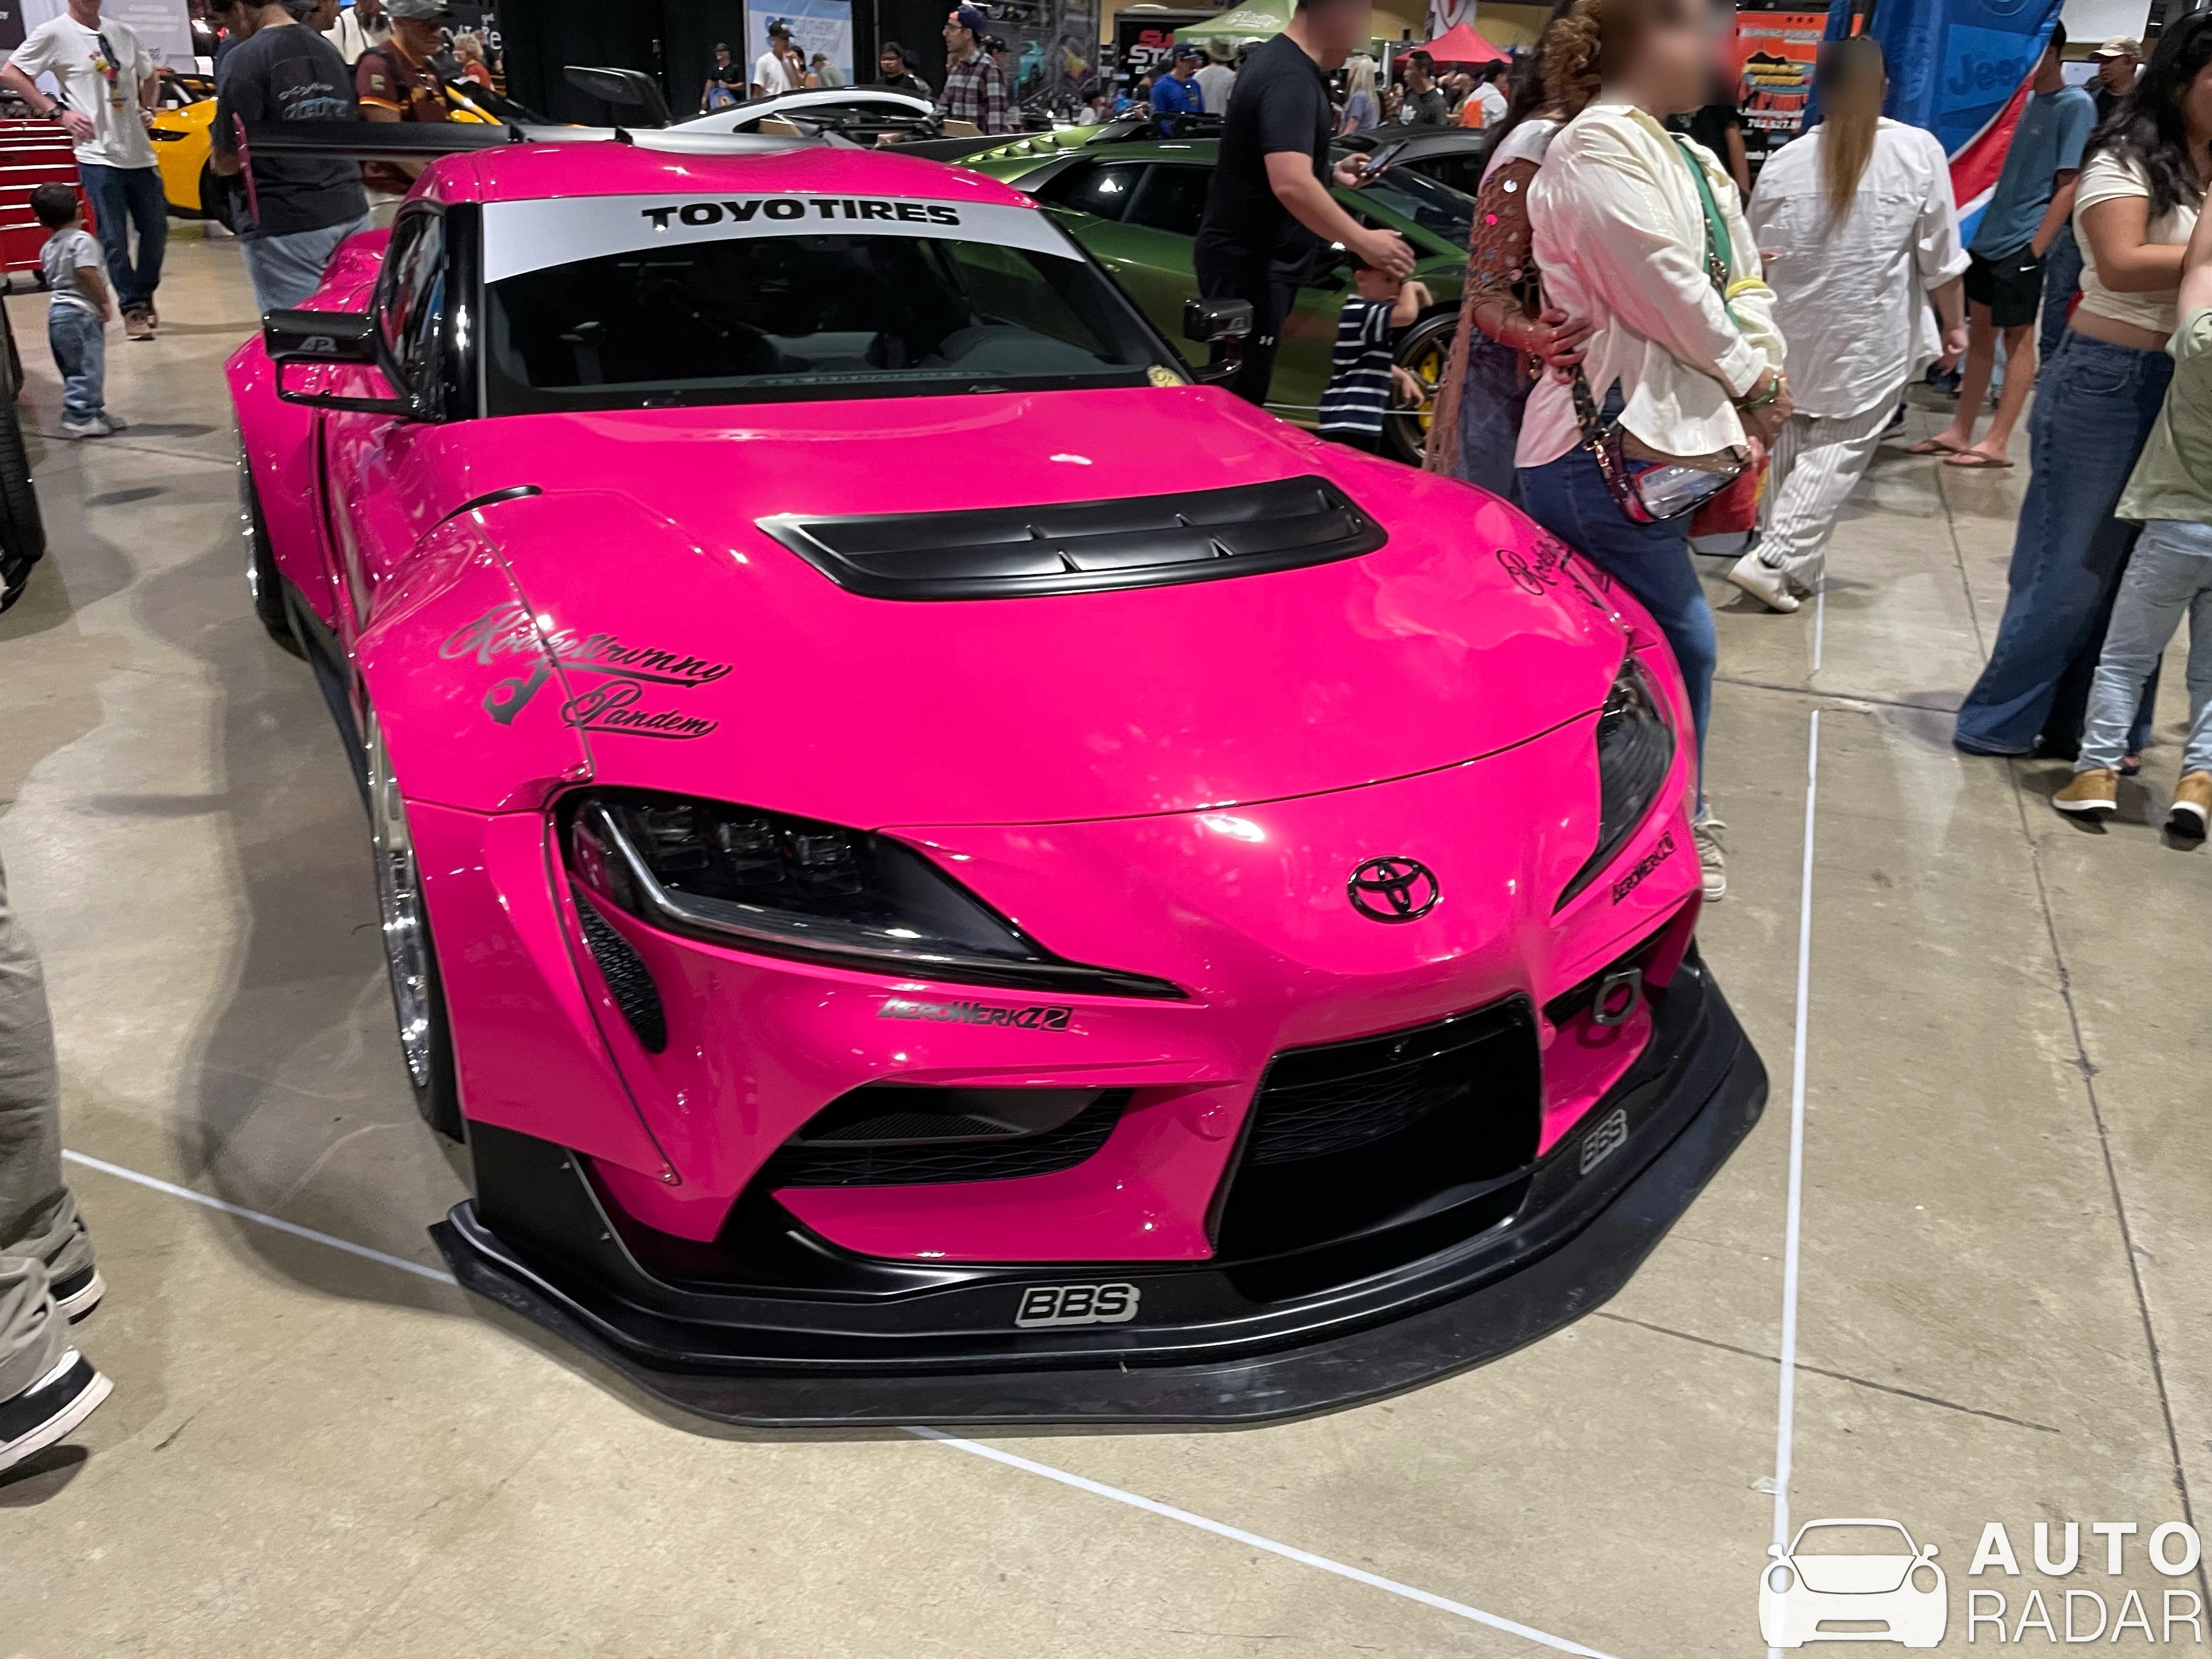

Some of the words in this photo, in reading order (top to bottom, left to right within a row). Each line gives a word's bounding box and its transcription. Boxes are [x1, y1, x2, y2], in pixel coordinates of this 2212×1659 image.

[642, 199, 805, 230] TOYO
[811, 199, 961, 226] TIRES
[562, 680, 719, 740] Pandem
[1580, 1110, 1627, 1172] BBS
[1017, 1284, 1136, 1324] BBS
